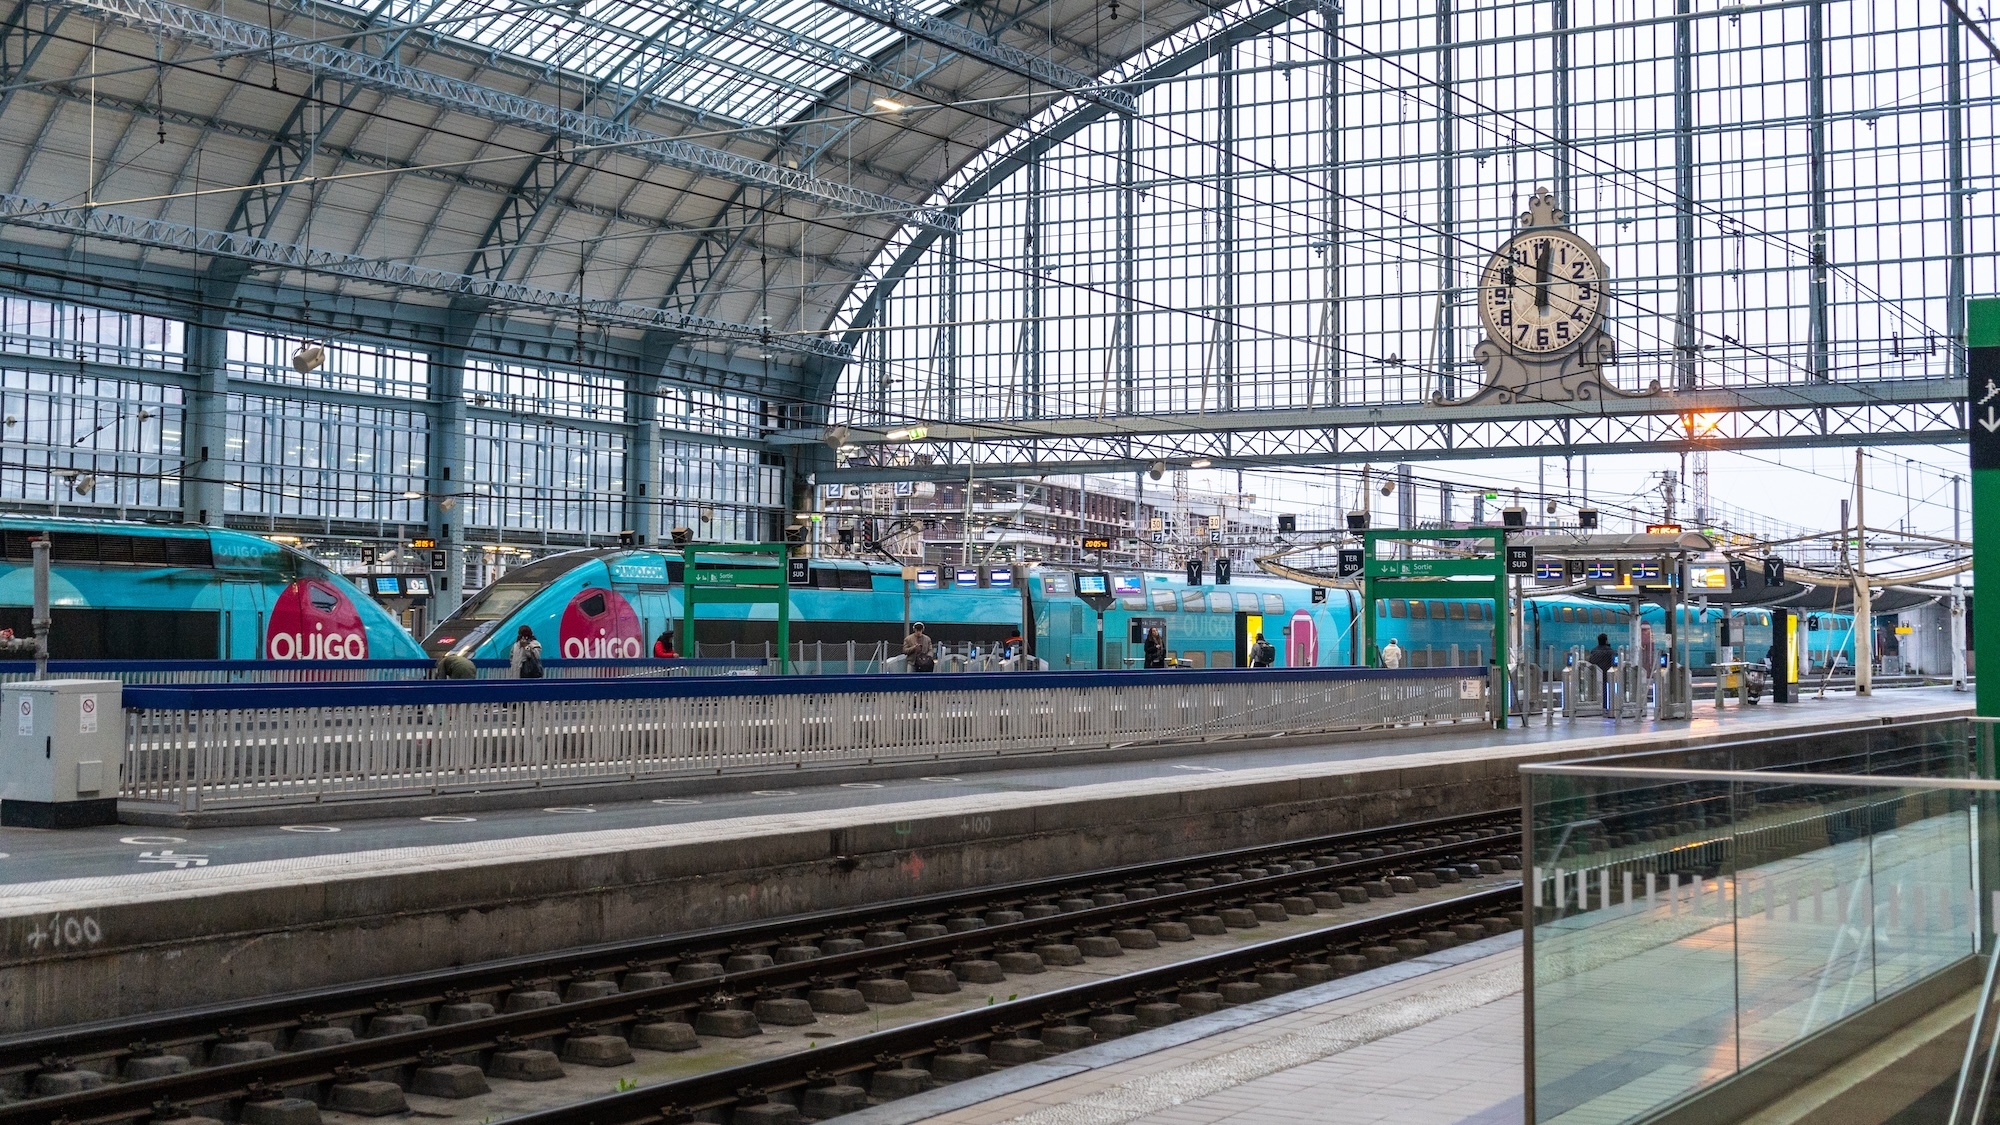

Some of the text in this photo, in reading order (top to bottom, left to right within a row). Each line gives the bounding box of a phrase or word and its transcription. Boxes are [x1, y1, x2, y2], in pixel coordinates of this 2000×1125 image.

[1560, 248, 1566, 265] 1
[1572, 261, 1585, 279] 2
[1494, 288, 1507, 305] 9
[1578, 282, 1591, 301] 3
[1500, 309, 1512, 326] 8
[1571, 304, 1585, 322] 4
[1517, 324, 1529, 341] 7
[1536, 328, 1549, 346] 6
[1556, 321, 1569, 339] 5
[829, 484, 839, 495] Z
[1152, 520, 1160, 528] 30
[1210, 518, 1219, 527] 30
[1212, 532, 1219, 540] Z
[1344, 554, 1358, 562] TER
[792, 570, 804, 578] SUD
[1190, 565, 1199, 577] Y
[1219, 564, 1228, 576] Y
[1344, 563, 1358, 572] SUD
[1413, 563, 1433, 571] Sortie
[1731, 566, 1742, 580] Y
[1769, 563, 1780, 577] Y
[1810, 619, 1817, 627] Z
[270, 622, 366, 660] OUIGO
[564, 628, 641, 659] OUIGO
[27, 912, 101, 950] +100
